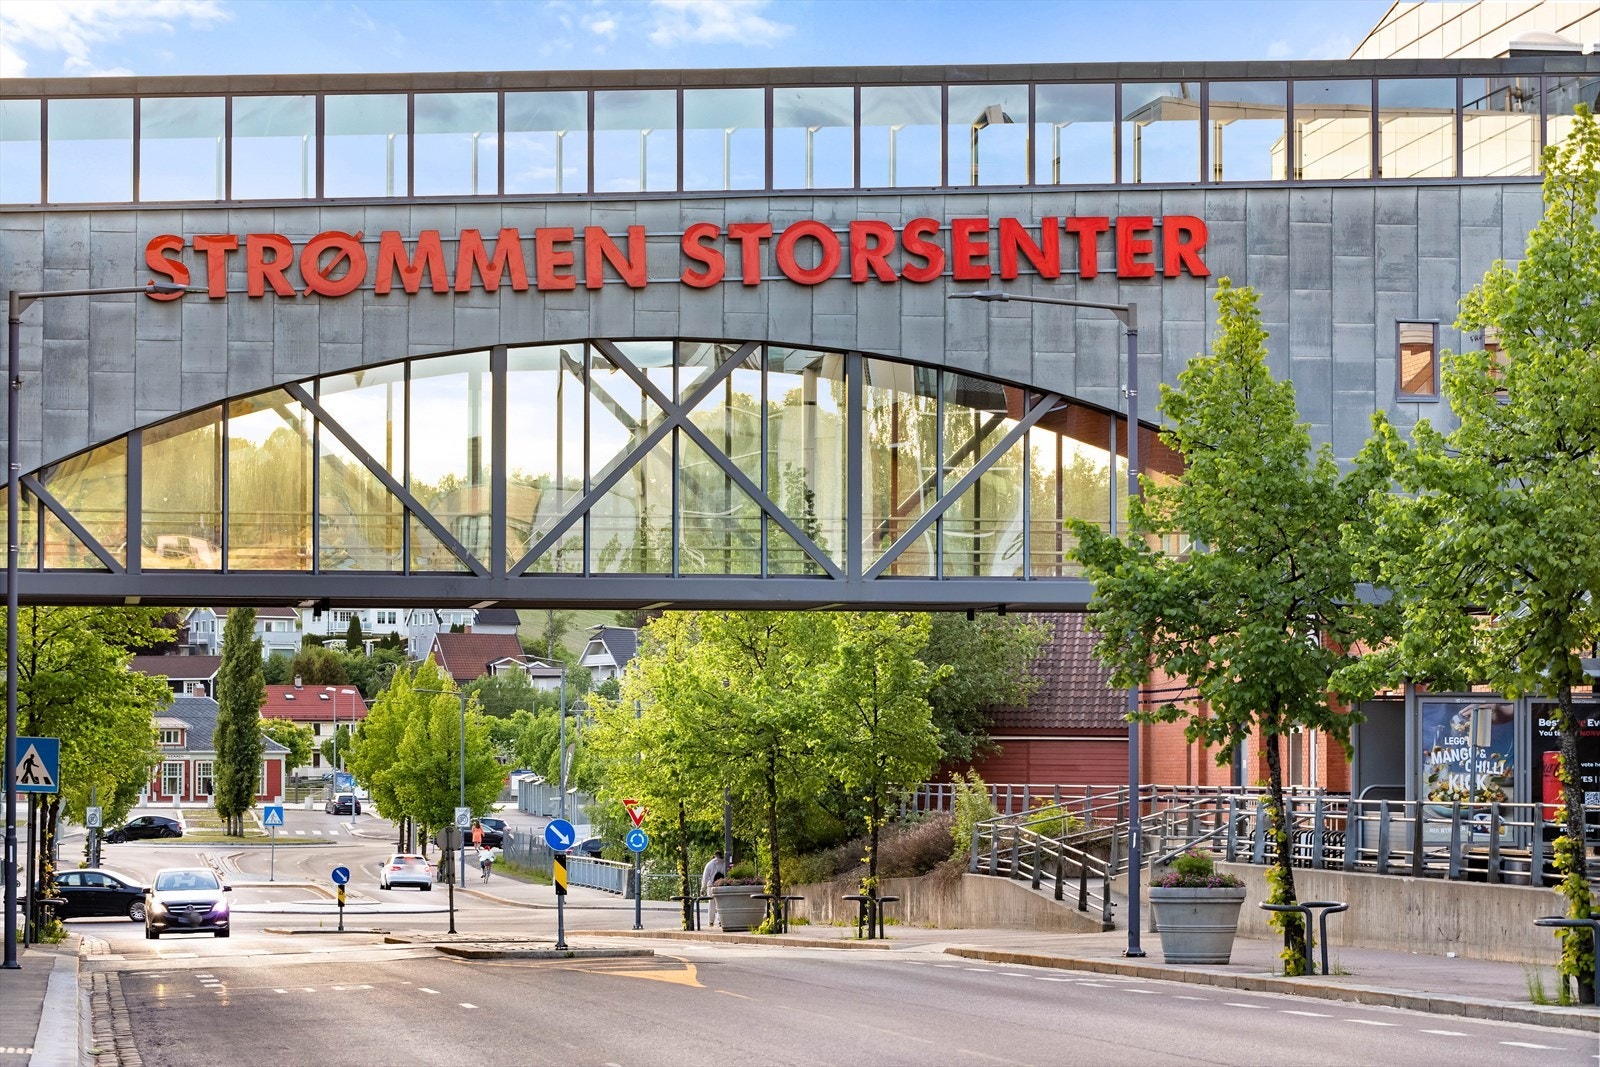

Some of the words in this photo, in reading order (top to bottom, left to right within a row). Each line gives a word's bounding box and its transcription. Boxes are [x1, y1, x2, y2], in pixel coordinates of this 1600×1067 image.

[145, 225, 648, 301] STRØMMEN
[680, 215, 1211, 288] STORSENTER
[1587, 718, 1600, 727] Ev
[1444, 736, 1465, 745] LEGG
[1479, 748, 1487, 759] &
